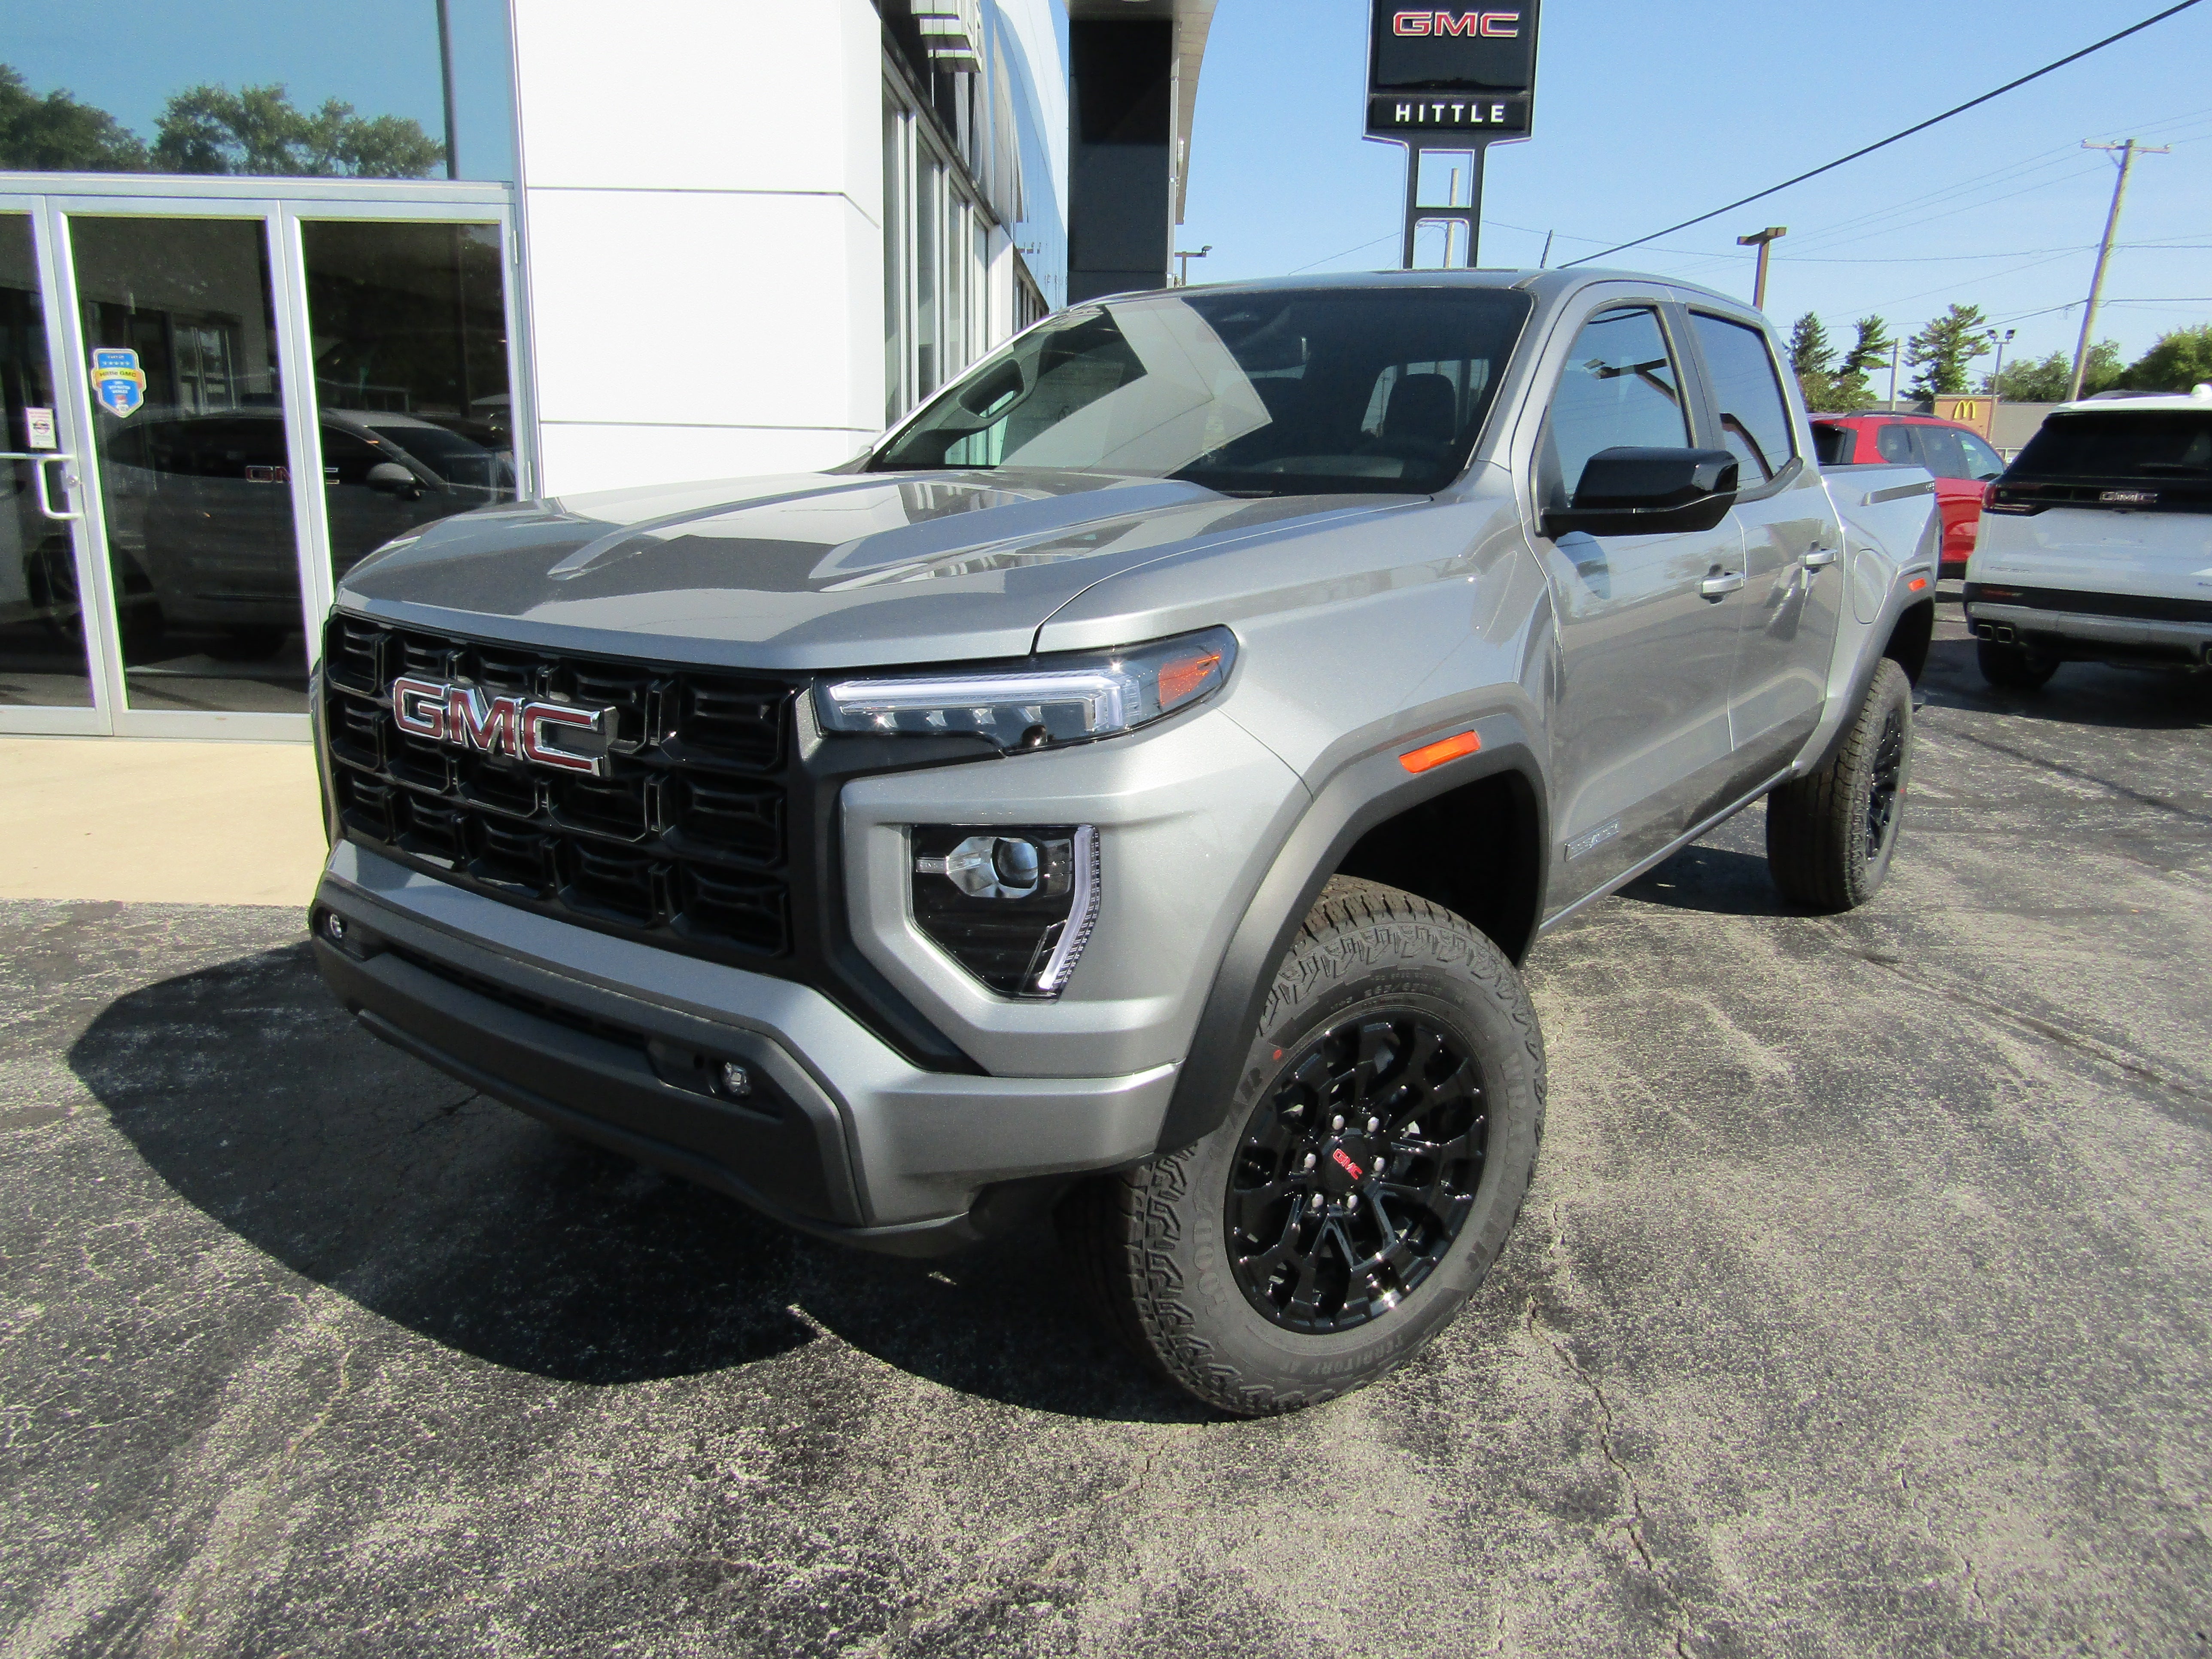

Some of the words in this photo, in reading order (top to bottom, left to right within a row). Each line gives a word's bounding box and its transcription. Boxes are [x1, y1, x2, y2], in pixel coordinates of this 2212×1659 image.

[1393, 11, 1519, 37] GMC
[1395, 104, 1504, 122] HITTLE
[2100, 491, 2158, 503] GMC
[394, 677, 603, 776] GMC
[1333, 1148, 1363, 1180] GMC
